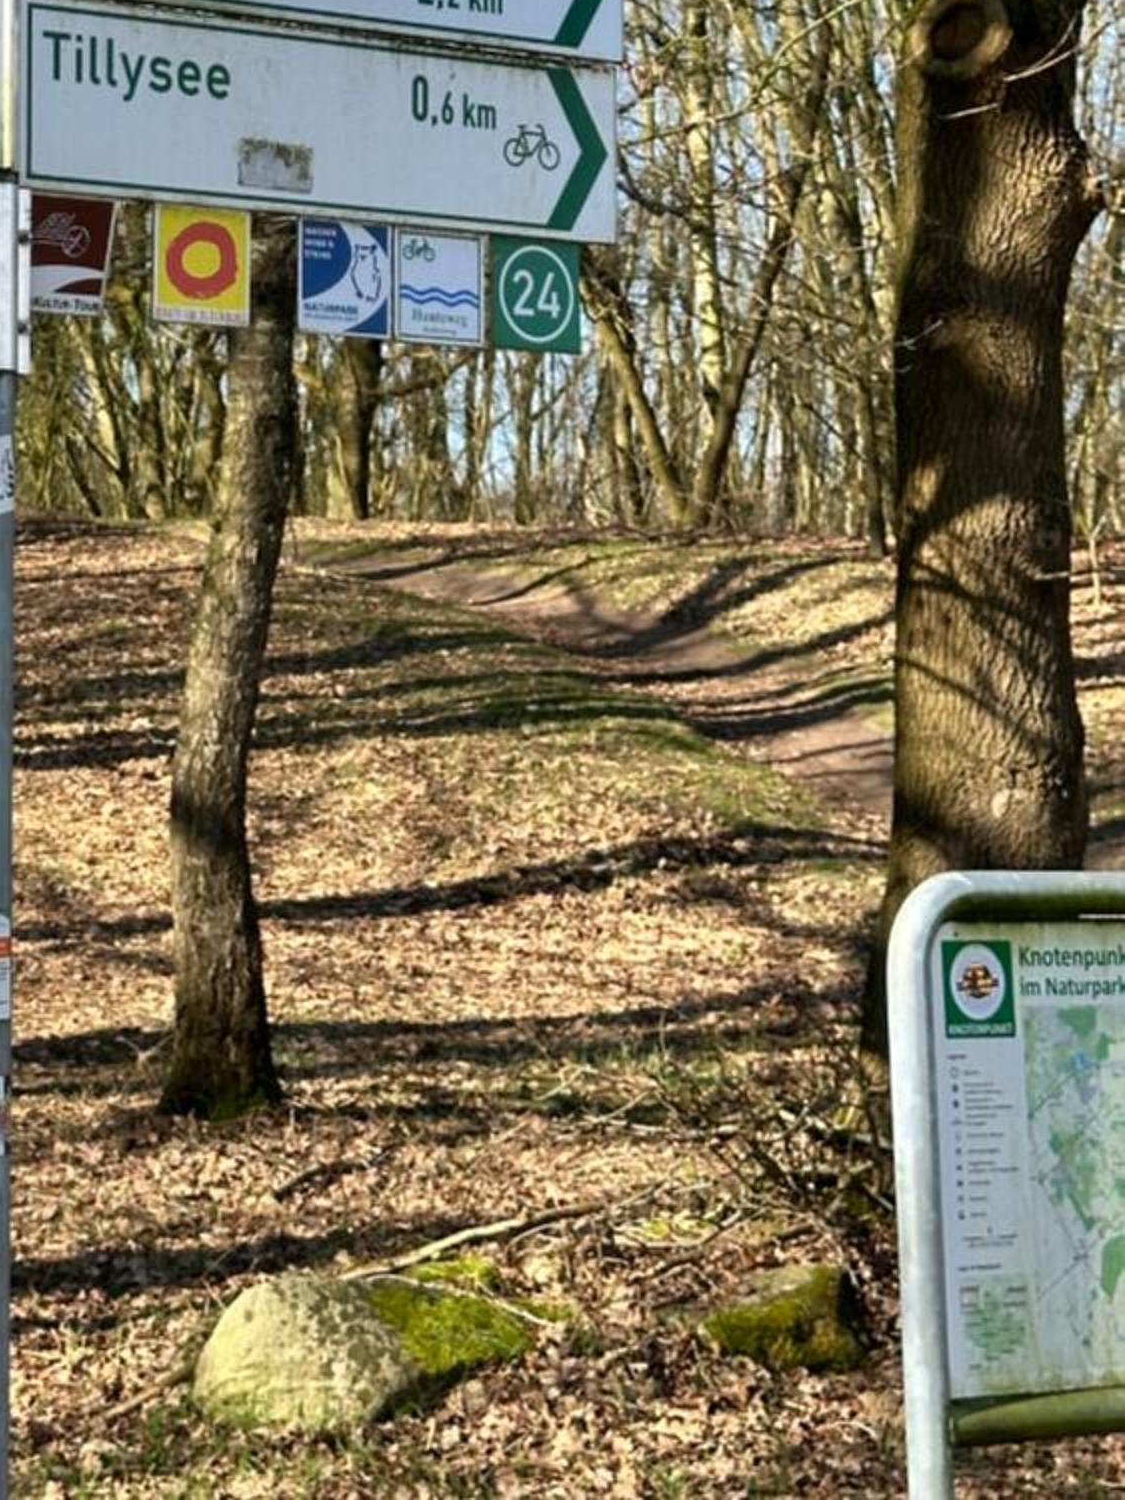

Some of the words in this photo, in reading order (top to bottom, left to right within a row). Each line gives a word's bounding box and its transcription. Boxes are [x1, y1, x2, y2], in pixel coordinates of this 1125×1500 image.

[43, 31, 230, 101] Tillysee
[412, 75, 454, 126] 0,6
[463, 94, 496, 130] km
[513, 268, 563, 321] 24
[1019, 976, 1041, 996] im
[1045, 975, 1125, 999] Naturpark
